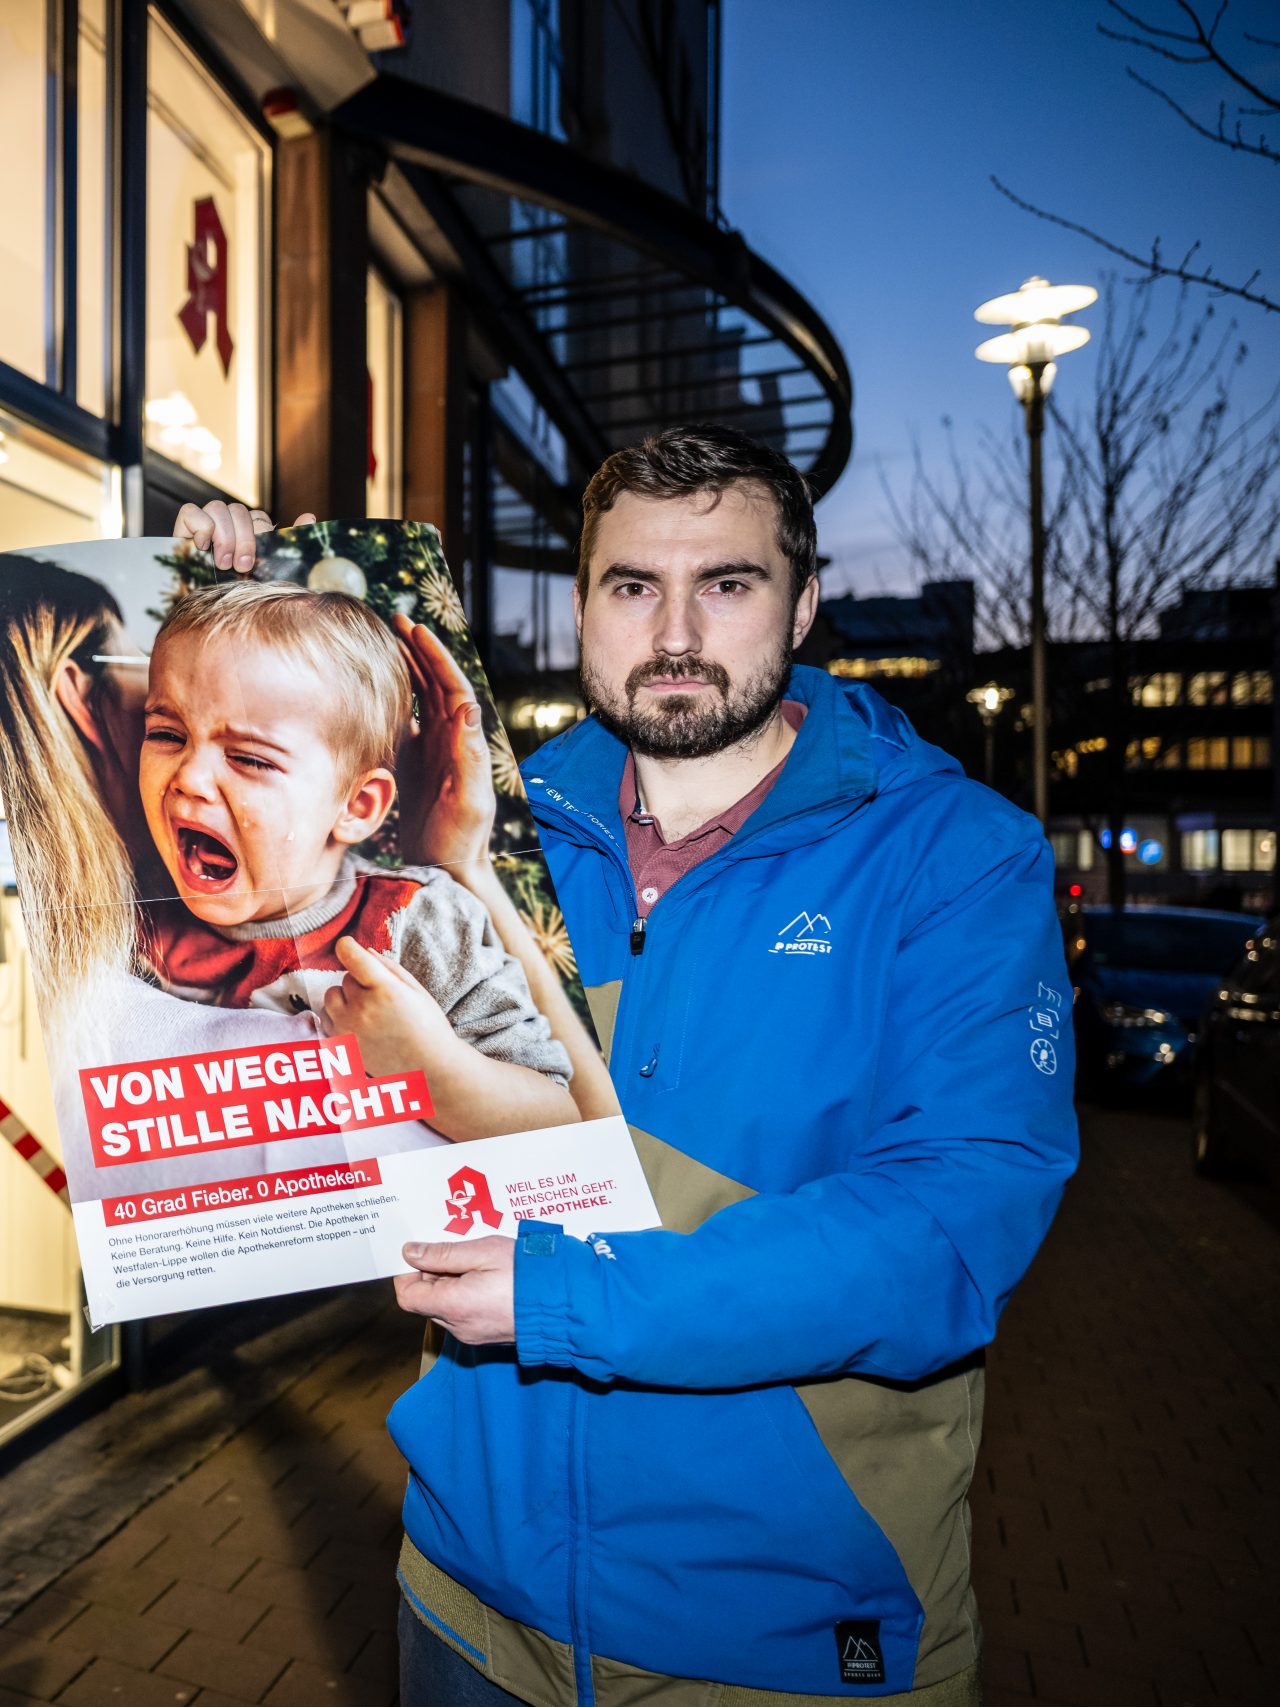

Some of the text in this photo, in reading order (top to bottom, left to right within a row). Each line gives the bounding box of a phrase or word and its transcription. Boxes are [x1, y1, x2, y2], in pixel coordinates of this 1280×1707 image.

[785, 942, 832, 954] PROTEST
[90, 1044, 352, 1109] VON WEGEN
[101, 1081, 421, 1157] STILLE NACHT.
[114, 1169, 372, 1220] 40 Grad Fieber. 0 Apotheken.
[505, 1173, 577, 1194] WEIL ES UM
[509, 1180, 617, 1207] MENSCHEN GEHT.
[513, 1195, 612, 1221] DIE APOTHEKE.
[108, 1194, 400, 1247] Ohne Honorarerhöhung müssen viele weitere Apotheken schließen.
[111, 1211, 380, 1261] Keine Beratung. Keine Hilfe. Kein Notdienst. Die Apotheken in
[113, 1255, 188, 1275] Westfalen-Lippe
[190, 1251, 219, 1263] wollen
[221, 1246, 235, 1257] die
[237, 1235, 314, 1256] Apothekenreform
[316, 1230, 351, 1243] stoppen
[359, 1224, 376, 1235] und
[116, 1265, 216, 1289] die Versorgung retten.
